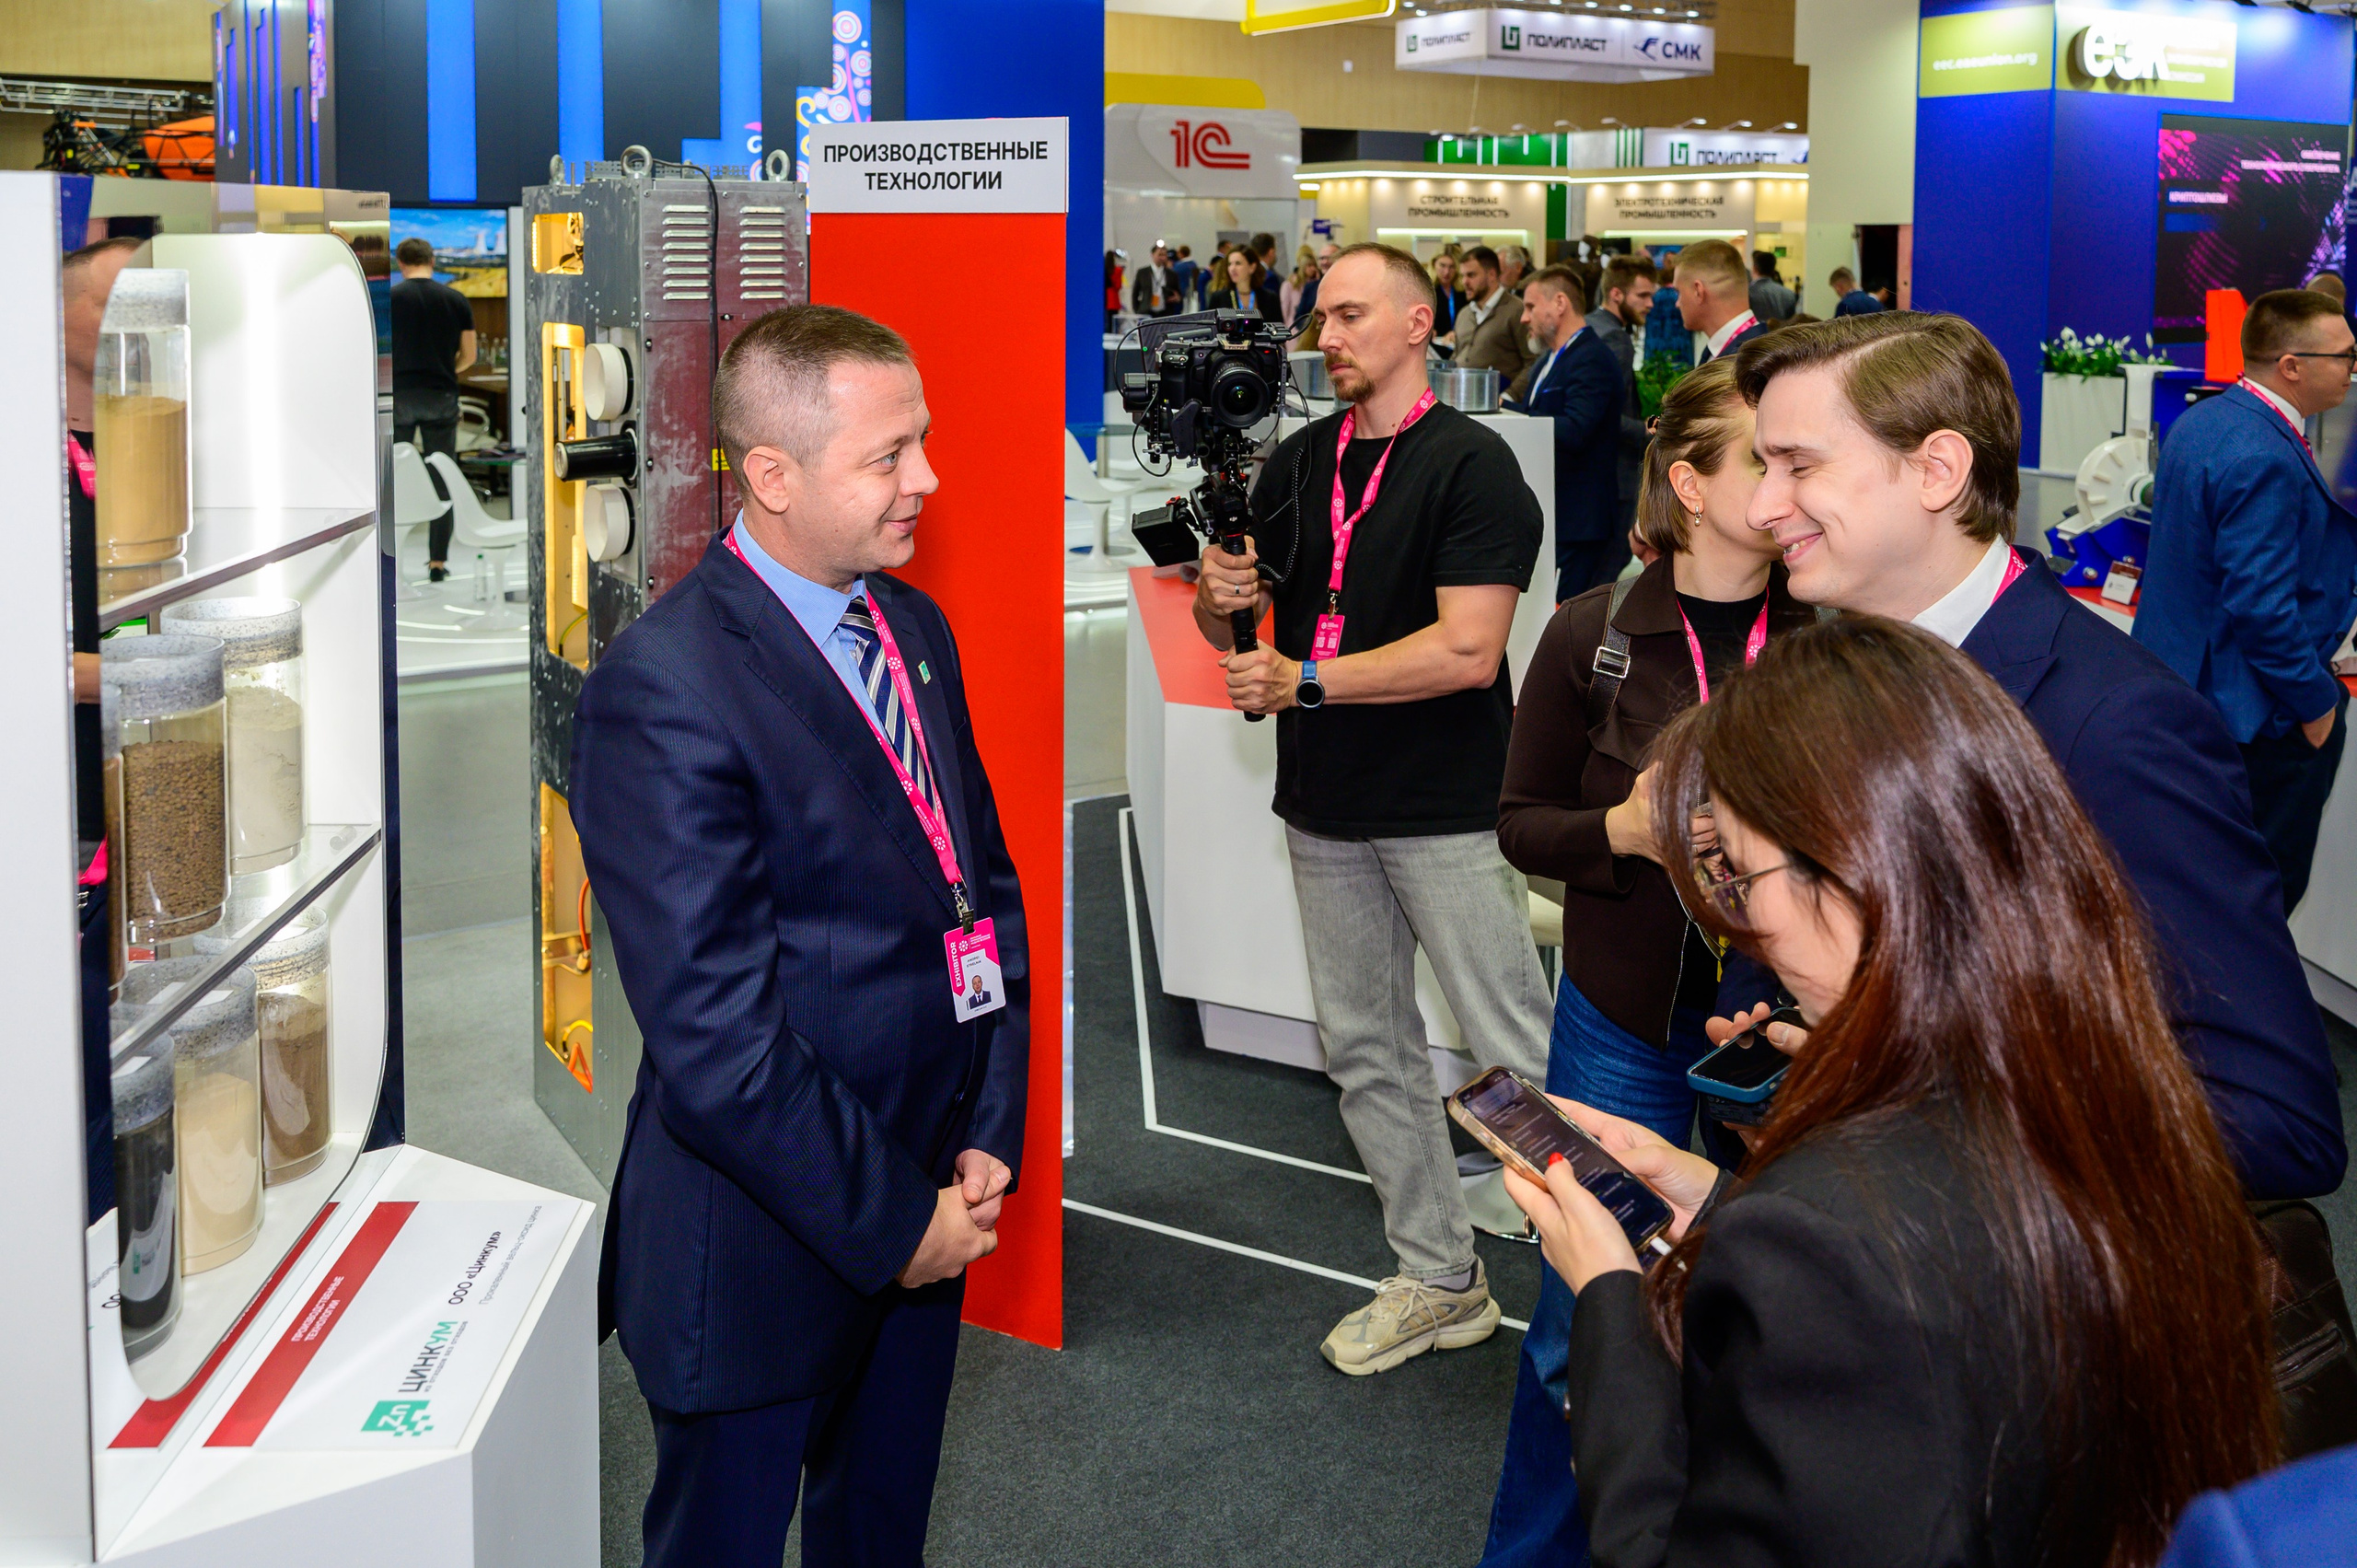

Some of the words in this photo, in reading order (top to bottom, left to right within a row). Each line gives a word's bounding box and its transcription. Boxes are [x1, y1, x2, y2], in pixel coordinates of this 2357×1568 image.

[1527, 34, 1607, 52] ПОЛИПЛАСТ
[1663, 41, 1701, 61] СМК
[824, 141, 1048, 165] ПРОИЗВОДСТВЕННЫЕ
[865, 171, 1002, 191] ТЕХНОЛОГИИ
[1408, 207, 1510, 217] ПРОМЫШЛЕННОСТЬ
[1620, 209, 1716, 218] ПРОМЫШЛЕННОСТЬ
[950, 942, 963, 987] EXHIBITOR
[527, 1205, 542, 1222] цинка
[448, 1282, 472, 1304] ООО
[465, 1231, 501, 1279] «Цинкум»
[291, 1276, 344, 1342] ПРОИЗВОДСТВЕННЫЕ
[304, 1299, 341, 1342] ТЕХНОЛОГИИ
[398, 1321, 459, 1392] ЦИНКУМ
